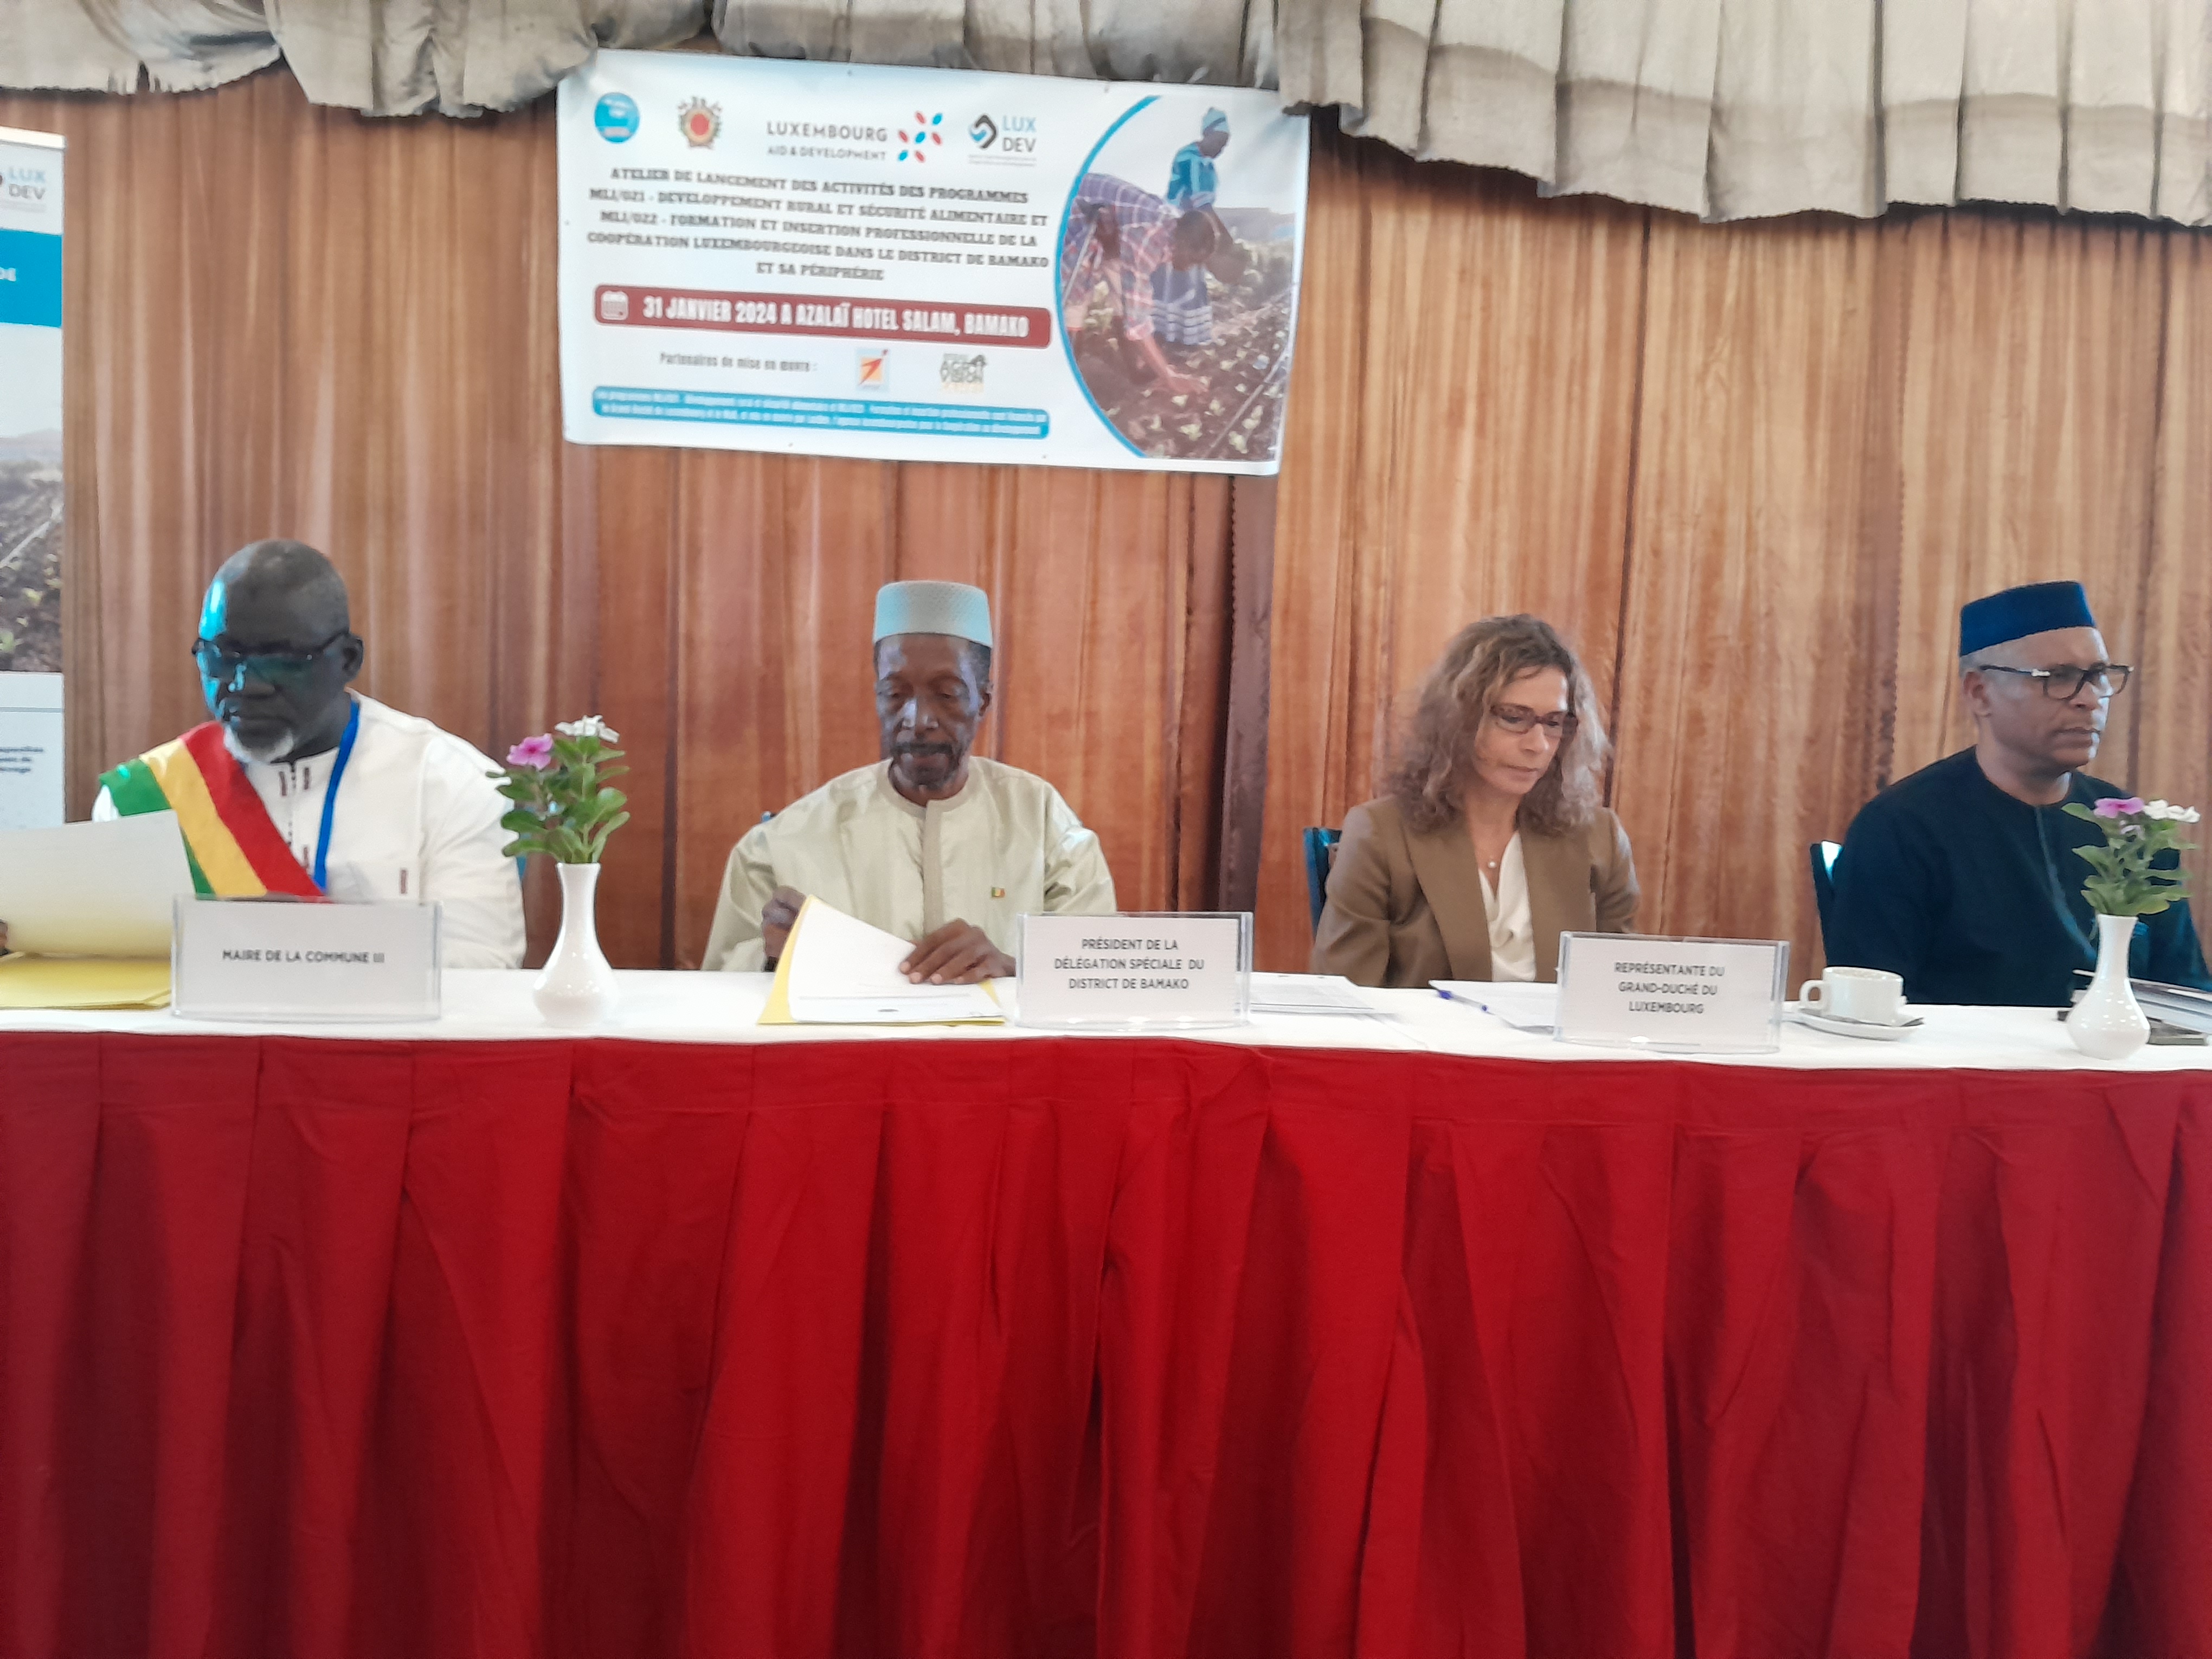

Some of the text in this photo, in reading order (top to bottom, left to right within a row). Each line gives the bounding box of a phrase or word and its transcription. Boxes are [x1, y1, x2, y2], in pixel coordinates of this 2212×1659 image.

[767, 121, 888, 142] LUXEMBOURG
[1002, 115, 1037, 132] LUX
[1002, 137, 1036, 153] DEV
[9, 167, 46, 183] LUX
[9, 183, 46, 200] DEV
[610, 168, 669, 181] ATELIER
[674, 170, 692, 182] DE
[697, 171, 786, 191] LANCEMENT
[792, 180, 816, 191] DES
[898, 185, 924, 198] DES
[929, 186, 1029, 204] PROGRAMMES
[787, 200, 834, 214] RURAL
[837, 203, 854, 215] ET
[929, 208, 1028, 226] ALIMENTAIRE
[1031, 214, 1049, 227] ET
[671, 214, 756, 229] FORMATION
[760, 218, 777, 230] ET
[782, 220, 861, 237] INSERTION
[865, 226, 995, 246] PROFESSIONNELLE
[999, 234, 1017, 246] DE
[1020, 234, 1037, 247] LA
[693, 236, 832, 256] LUXEMBOURGEOISE
[834, 245, 874, 259] DANS
[877, 248, 895, 261] LE
[898, 249, 962, 265] DISTRICT
[966, 253, 985, 266] DE
[988, 254, 1049, 268] BAMAKO
[756, 261, 773, 274] ET
[777, 263, 796, 275] SA
[642, 295, 664, 319] 31
[665, 297, 732, 324] JANVIER
[735, 299, 777, 325] 2024
[852, 306, 899, 331] HOTEL
[901, 307, 961, 336] SALAM,
[963, 311, 1030, 338] BAMAKO
[1082, 936, 1178, 950] PRÉSIDENT DE LA
[222, 949, 262, 961] MAIRE
[265, 950, 281, 962] DE
[286, 950, 300, 962] LA
[305, 950, 370, 963] COMMUNE
[1054, 956, 1205, 970] DÉLÉGATION SPÉCIALE DU
[1613, 960, 1726, 976] REPRÉSENTANTE DU
[1069, 978, 1189, 989] DISTRICT DE BAMAKO
[1618, 981, 1718, 995] GRAND-DUCHÉ DU
[1628, 1001, 1705, 1014] LUXEMBOURG
